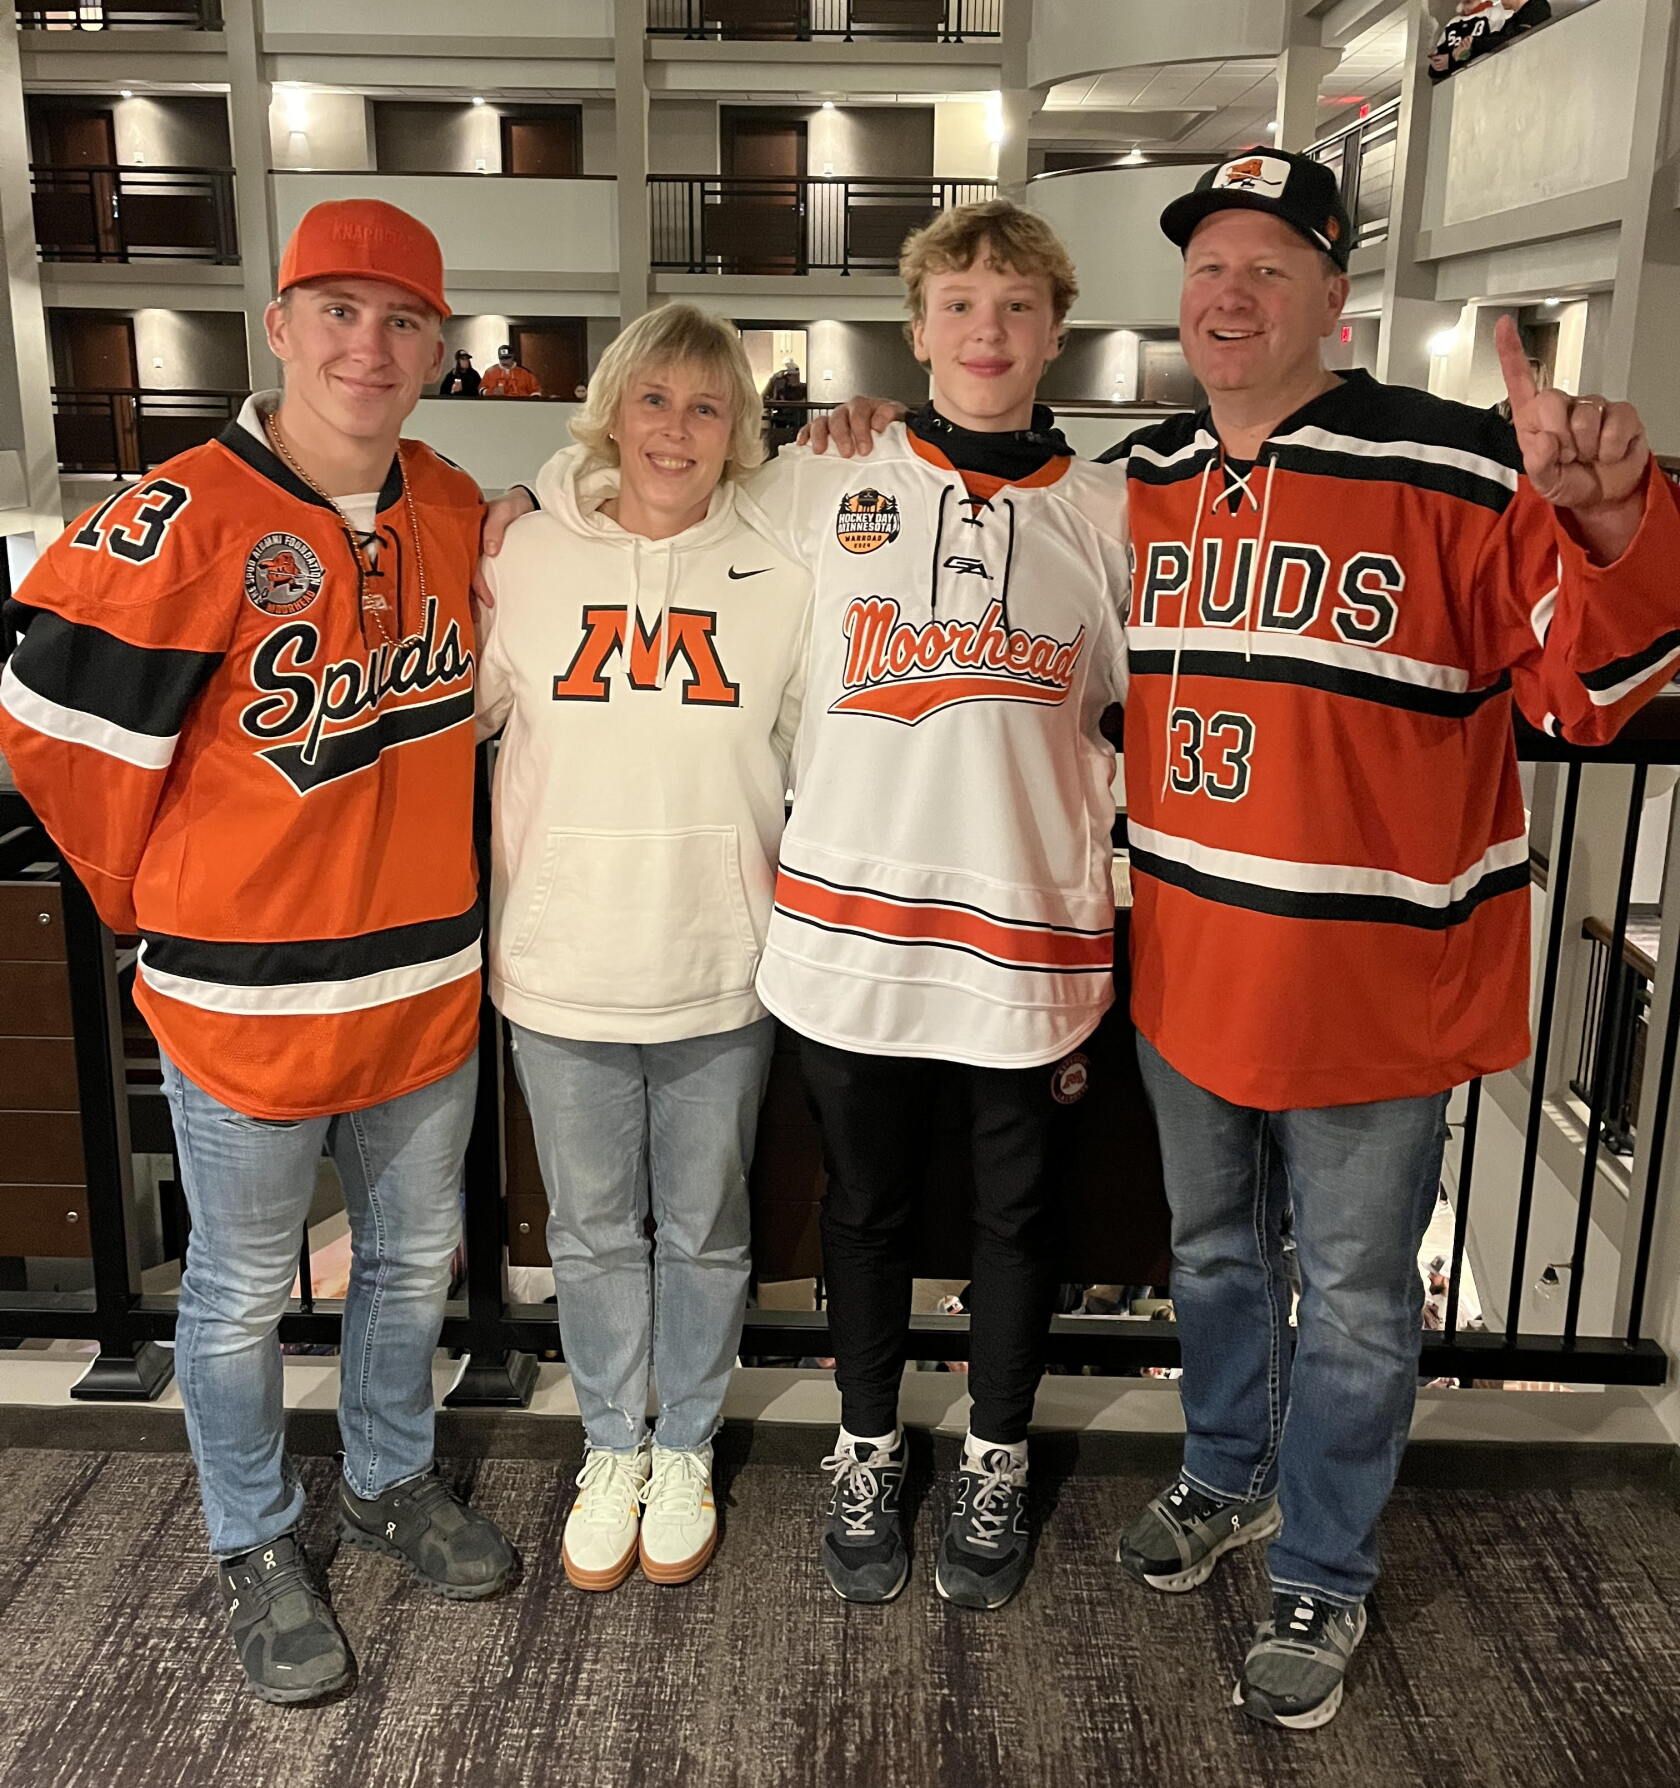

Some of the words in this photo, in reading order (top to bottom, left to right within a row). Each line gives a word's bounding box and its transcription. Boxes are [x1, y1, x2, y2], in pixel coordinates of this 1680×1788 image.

[69, 477, 192, 565] 13
[245, 560, 255, 586] SPUD
[252, 535, 283, 559] ALUMNI
[284, 536, 321, 586] FOUNDATION
[838, 523, 892, 533] MINNESOTA
[839, 513, 874, 523] HOCKEY
[875, 513, 894, 523] DAY
[266, 590, 316, 614] MOORHEAD
[843, 594, 1086, 691] Moorhead
[240, 597, 474, 764] Spuds
[553, 605, 740, 707] M
[1169, 708, 1258, 803] 33
